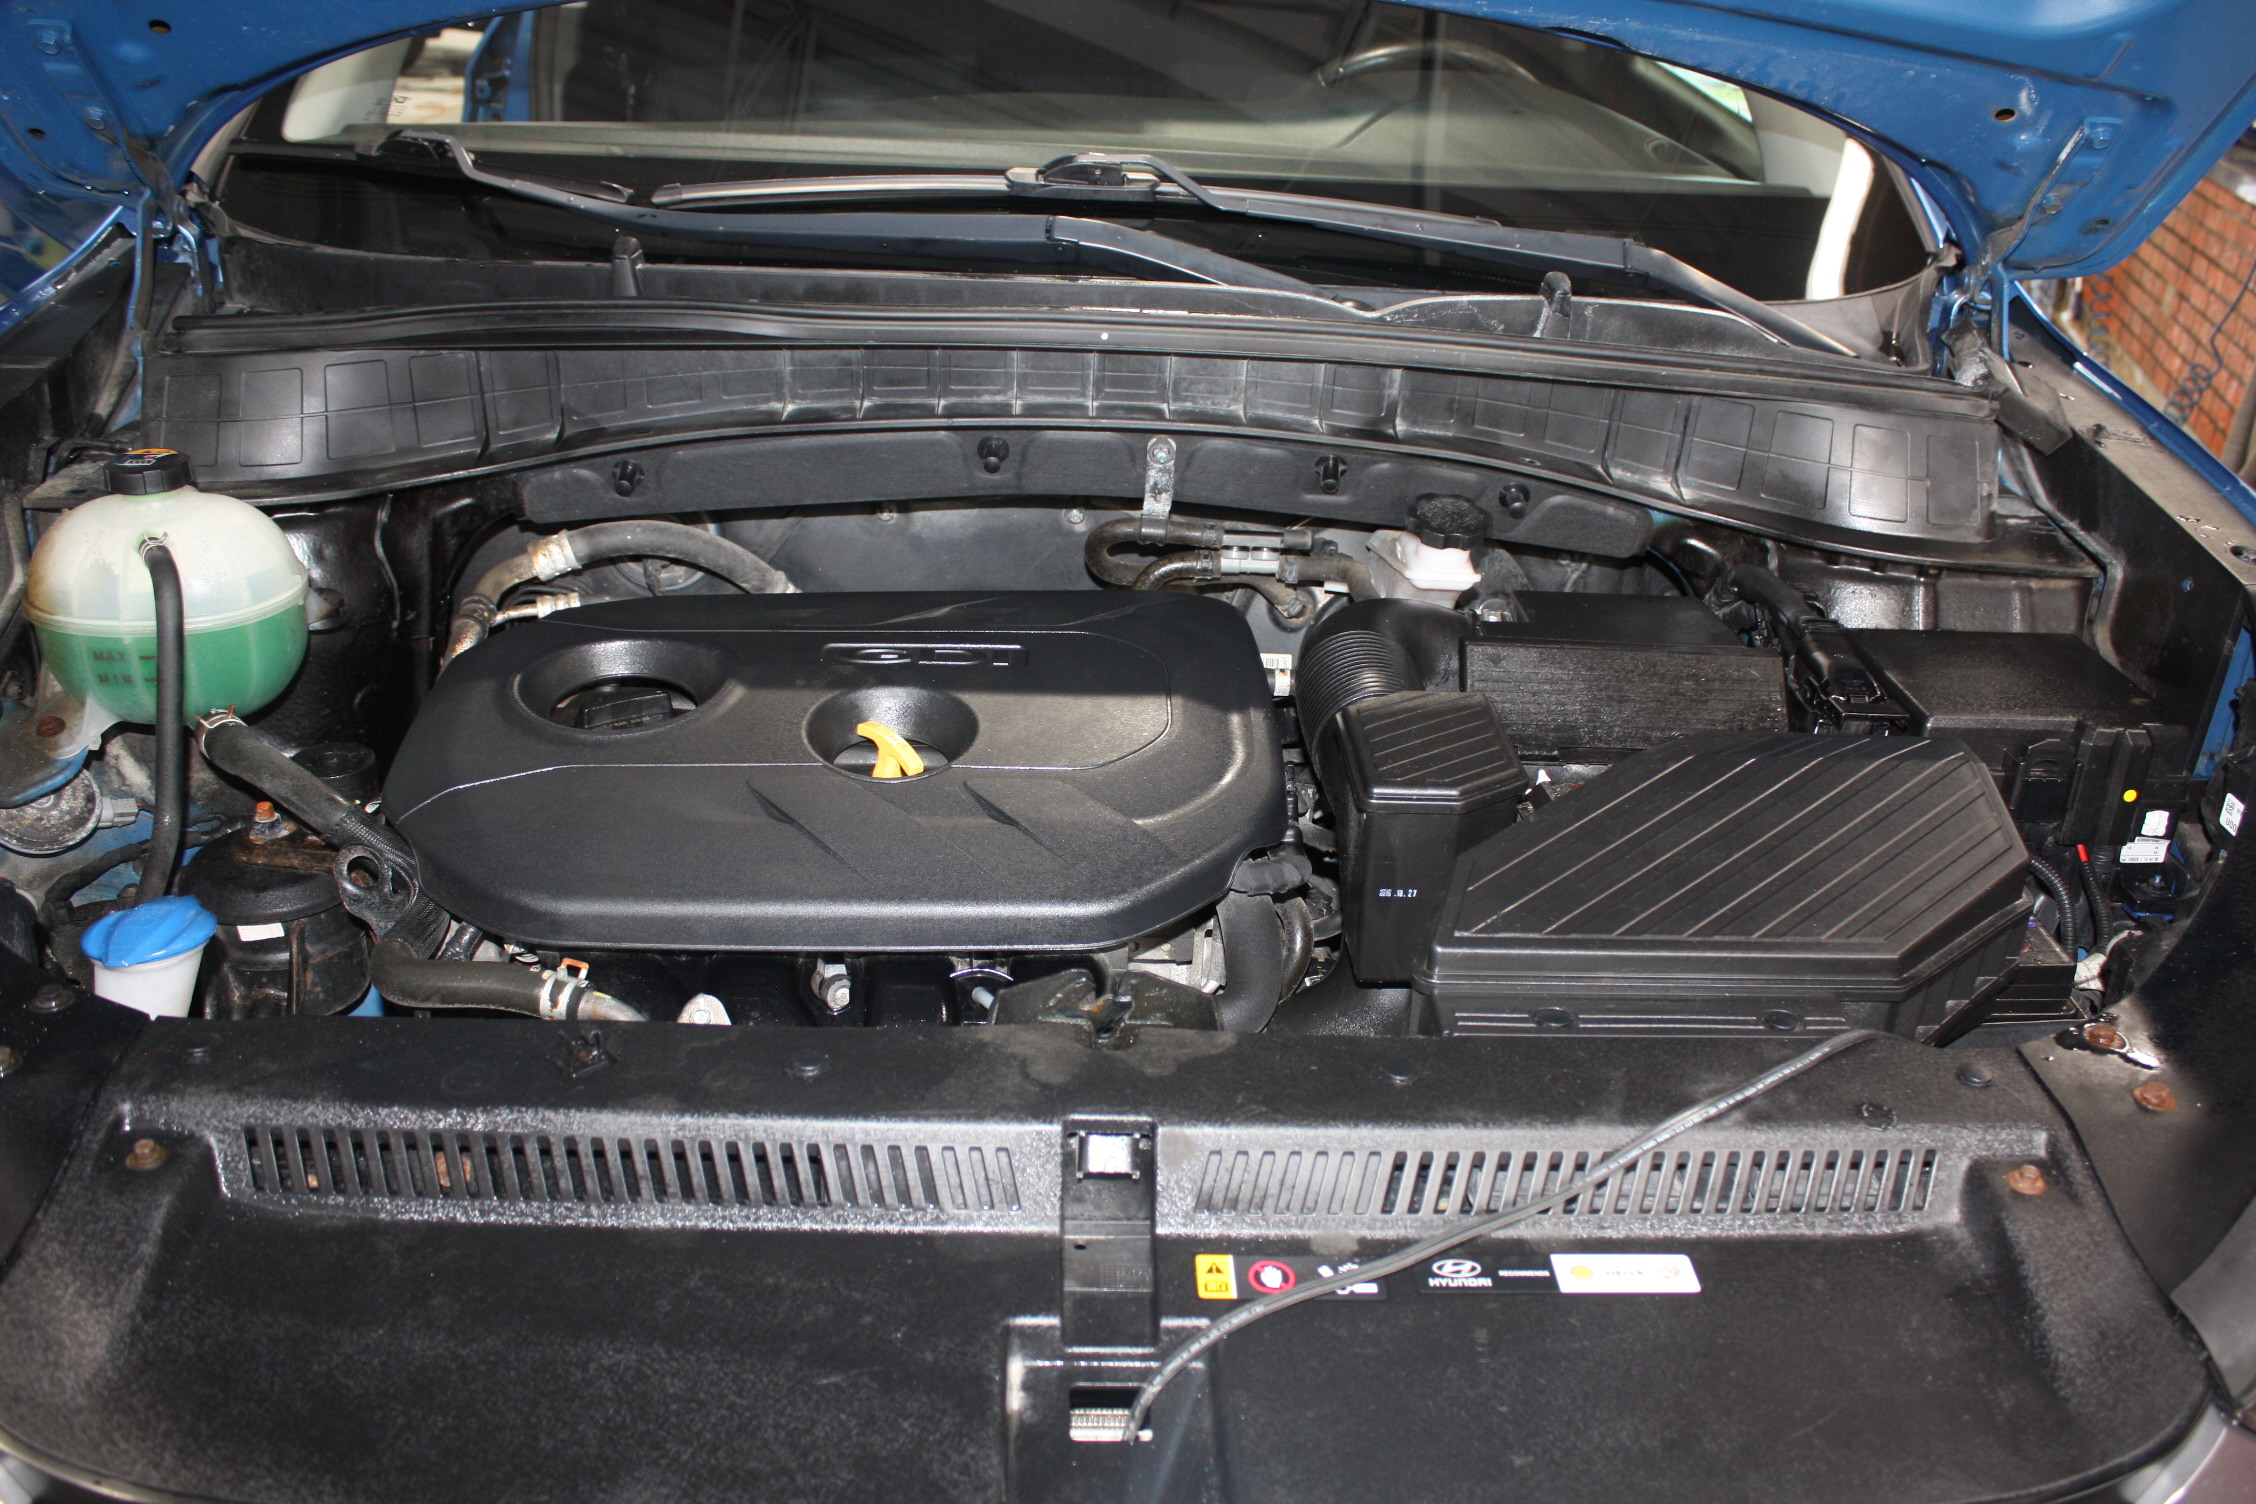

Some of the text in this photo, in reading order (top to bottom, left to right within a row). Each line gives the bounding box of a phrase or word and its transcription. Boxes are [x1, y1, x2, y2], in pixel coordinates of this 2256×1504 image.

[92, 651, 127, 663] MAX
[98, 674, 132, 685] MIN
[1428, 1277, 1493, 1288] HYUNDAI
